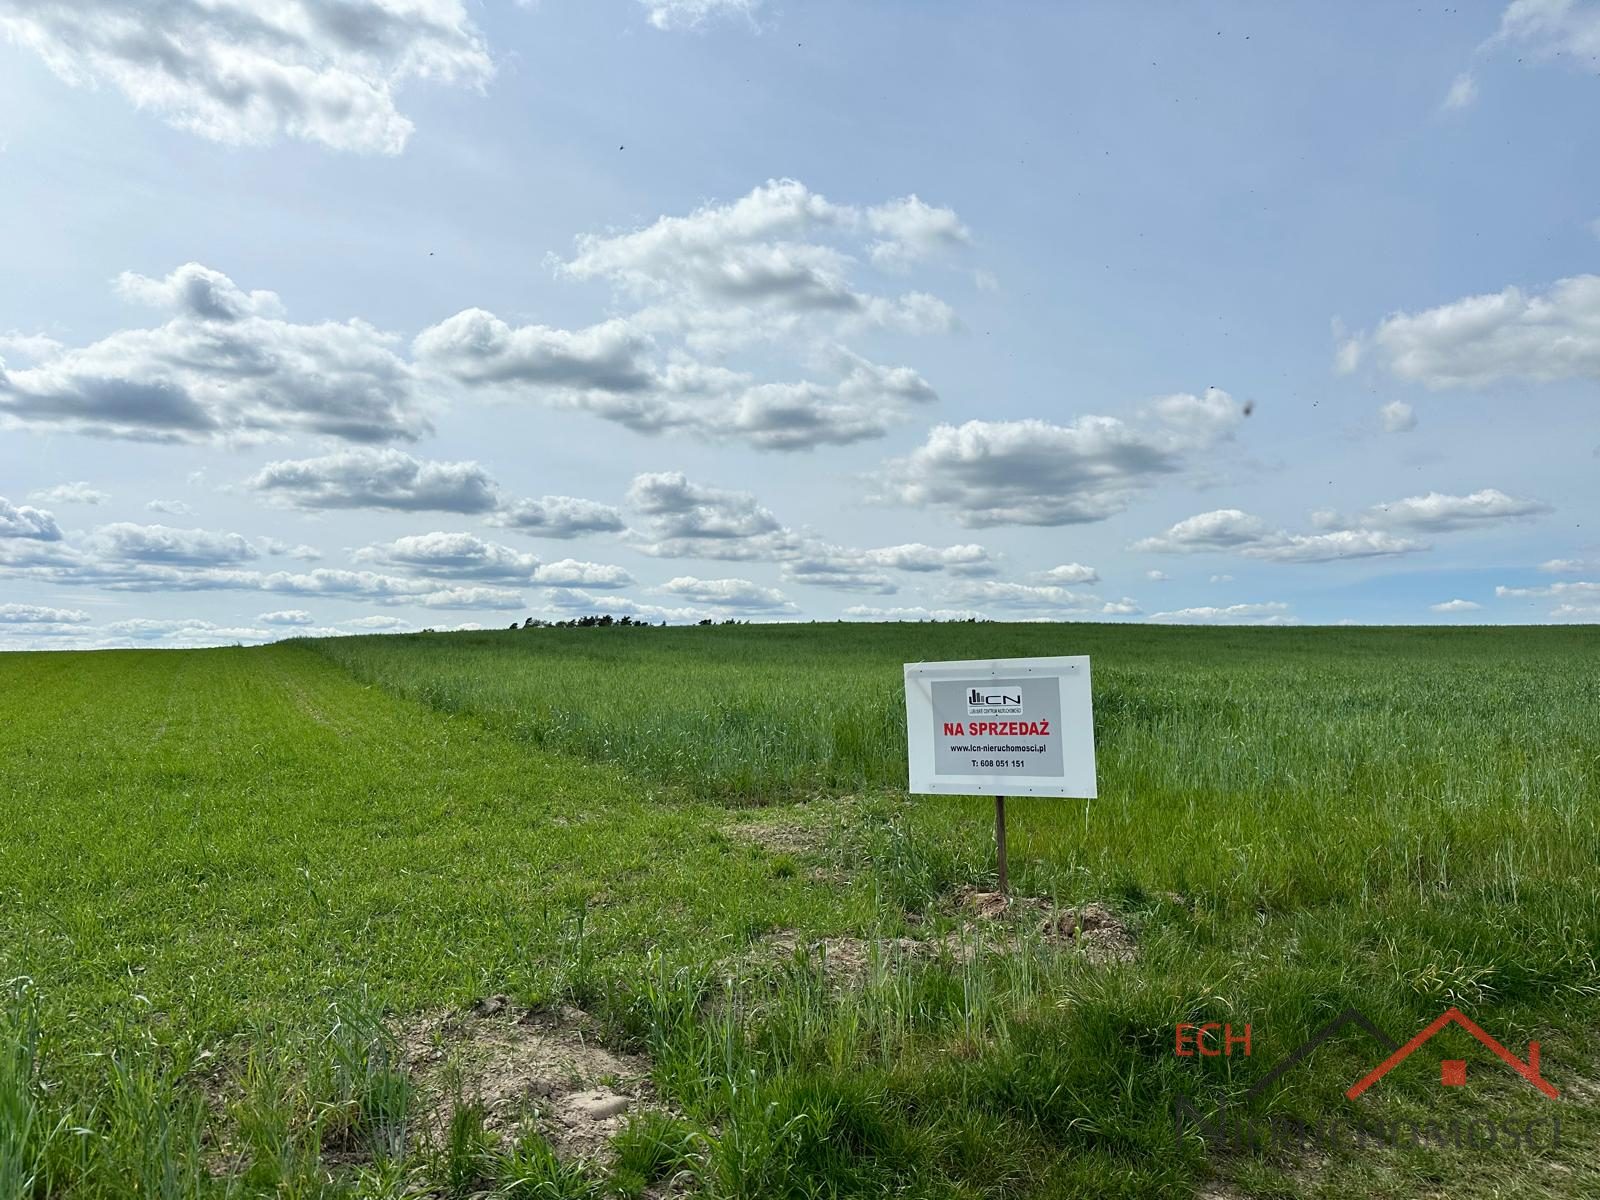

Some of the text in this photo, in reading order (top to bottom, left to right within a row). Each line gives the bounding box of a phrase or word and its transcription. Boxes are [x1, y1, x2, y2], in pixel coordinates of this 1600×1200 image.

[944, 719, 1050, 736] NA SPRZEDAŻ
[950, 744, 1046, 754] www.lcn-nieruchomosci.pl
